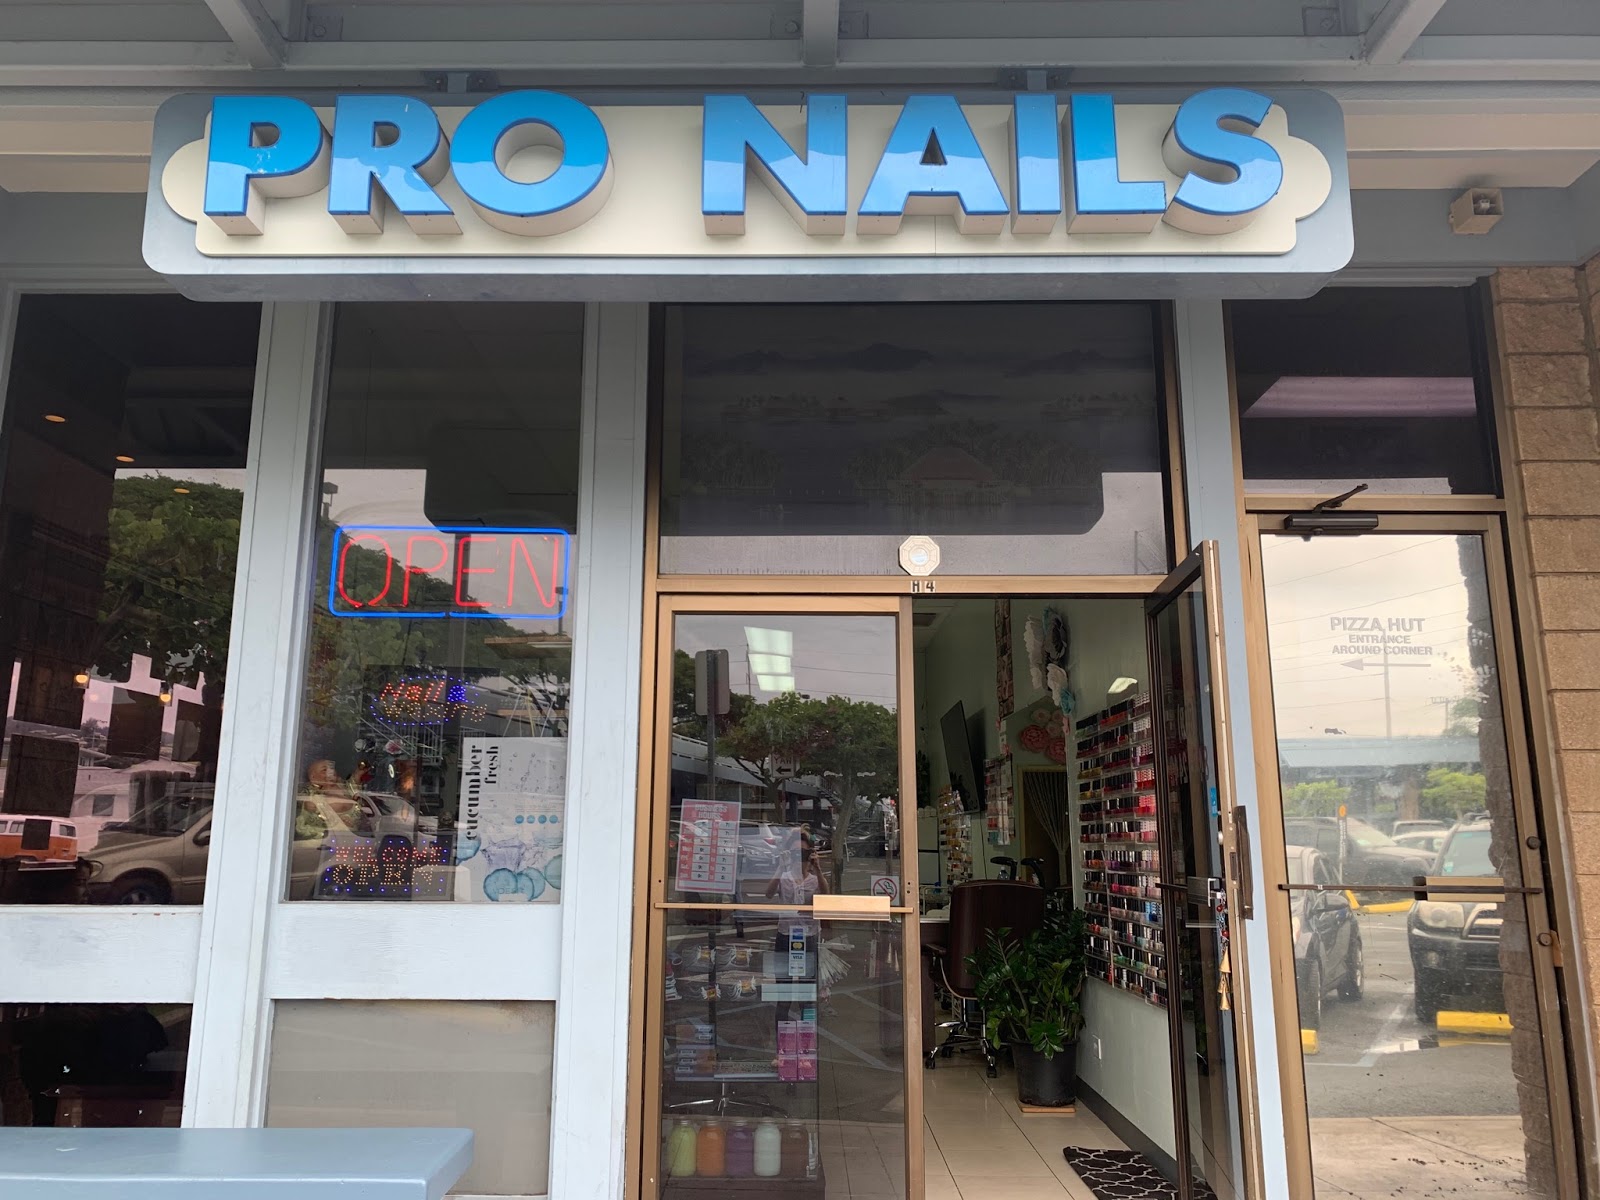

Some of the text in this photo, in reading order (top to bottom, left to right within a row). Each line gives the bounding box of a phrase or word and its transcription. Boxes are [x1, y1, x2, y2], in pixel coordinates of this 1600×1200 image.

[204, 87, 1284, 217] PRO NAILS
[338, 534, 559, 608] OPEN
[1330, 617, 1426, 632] PIZZA HUT
[1332, 645, 1433, 655] AROUND CORNER
[1348, 634, 1412, 644] ENTRANCE
[484, 746, 499, 784] fresh
[465, 745, 482, 841] cucumber
[335, 846, 443, 862] WELCOME
[332, 863, 440, 886] OPEN
